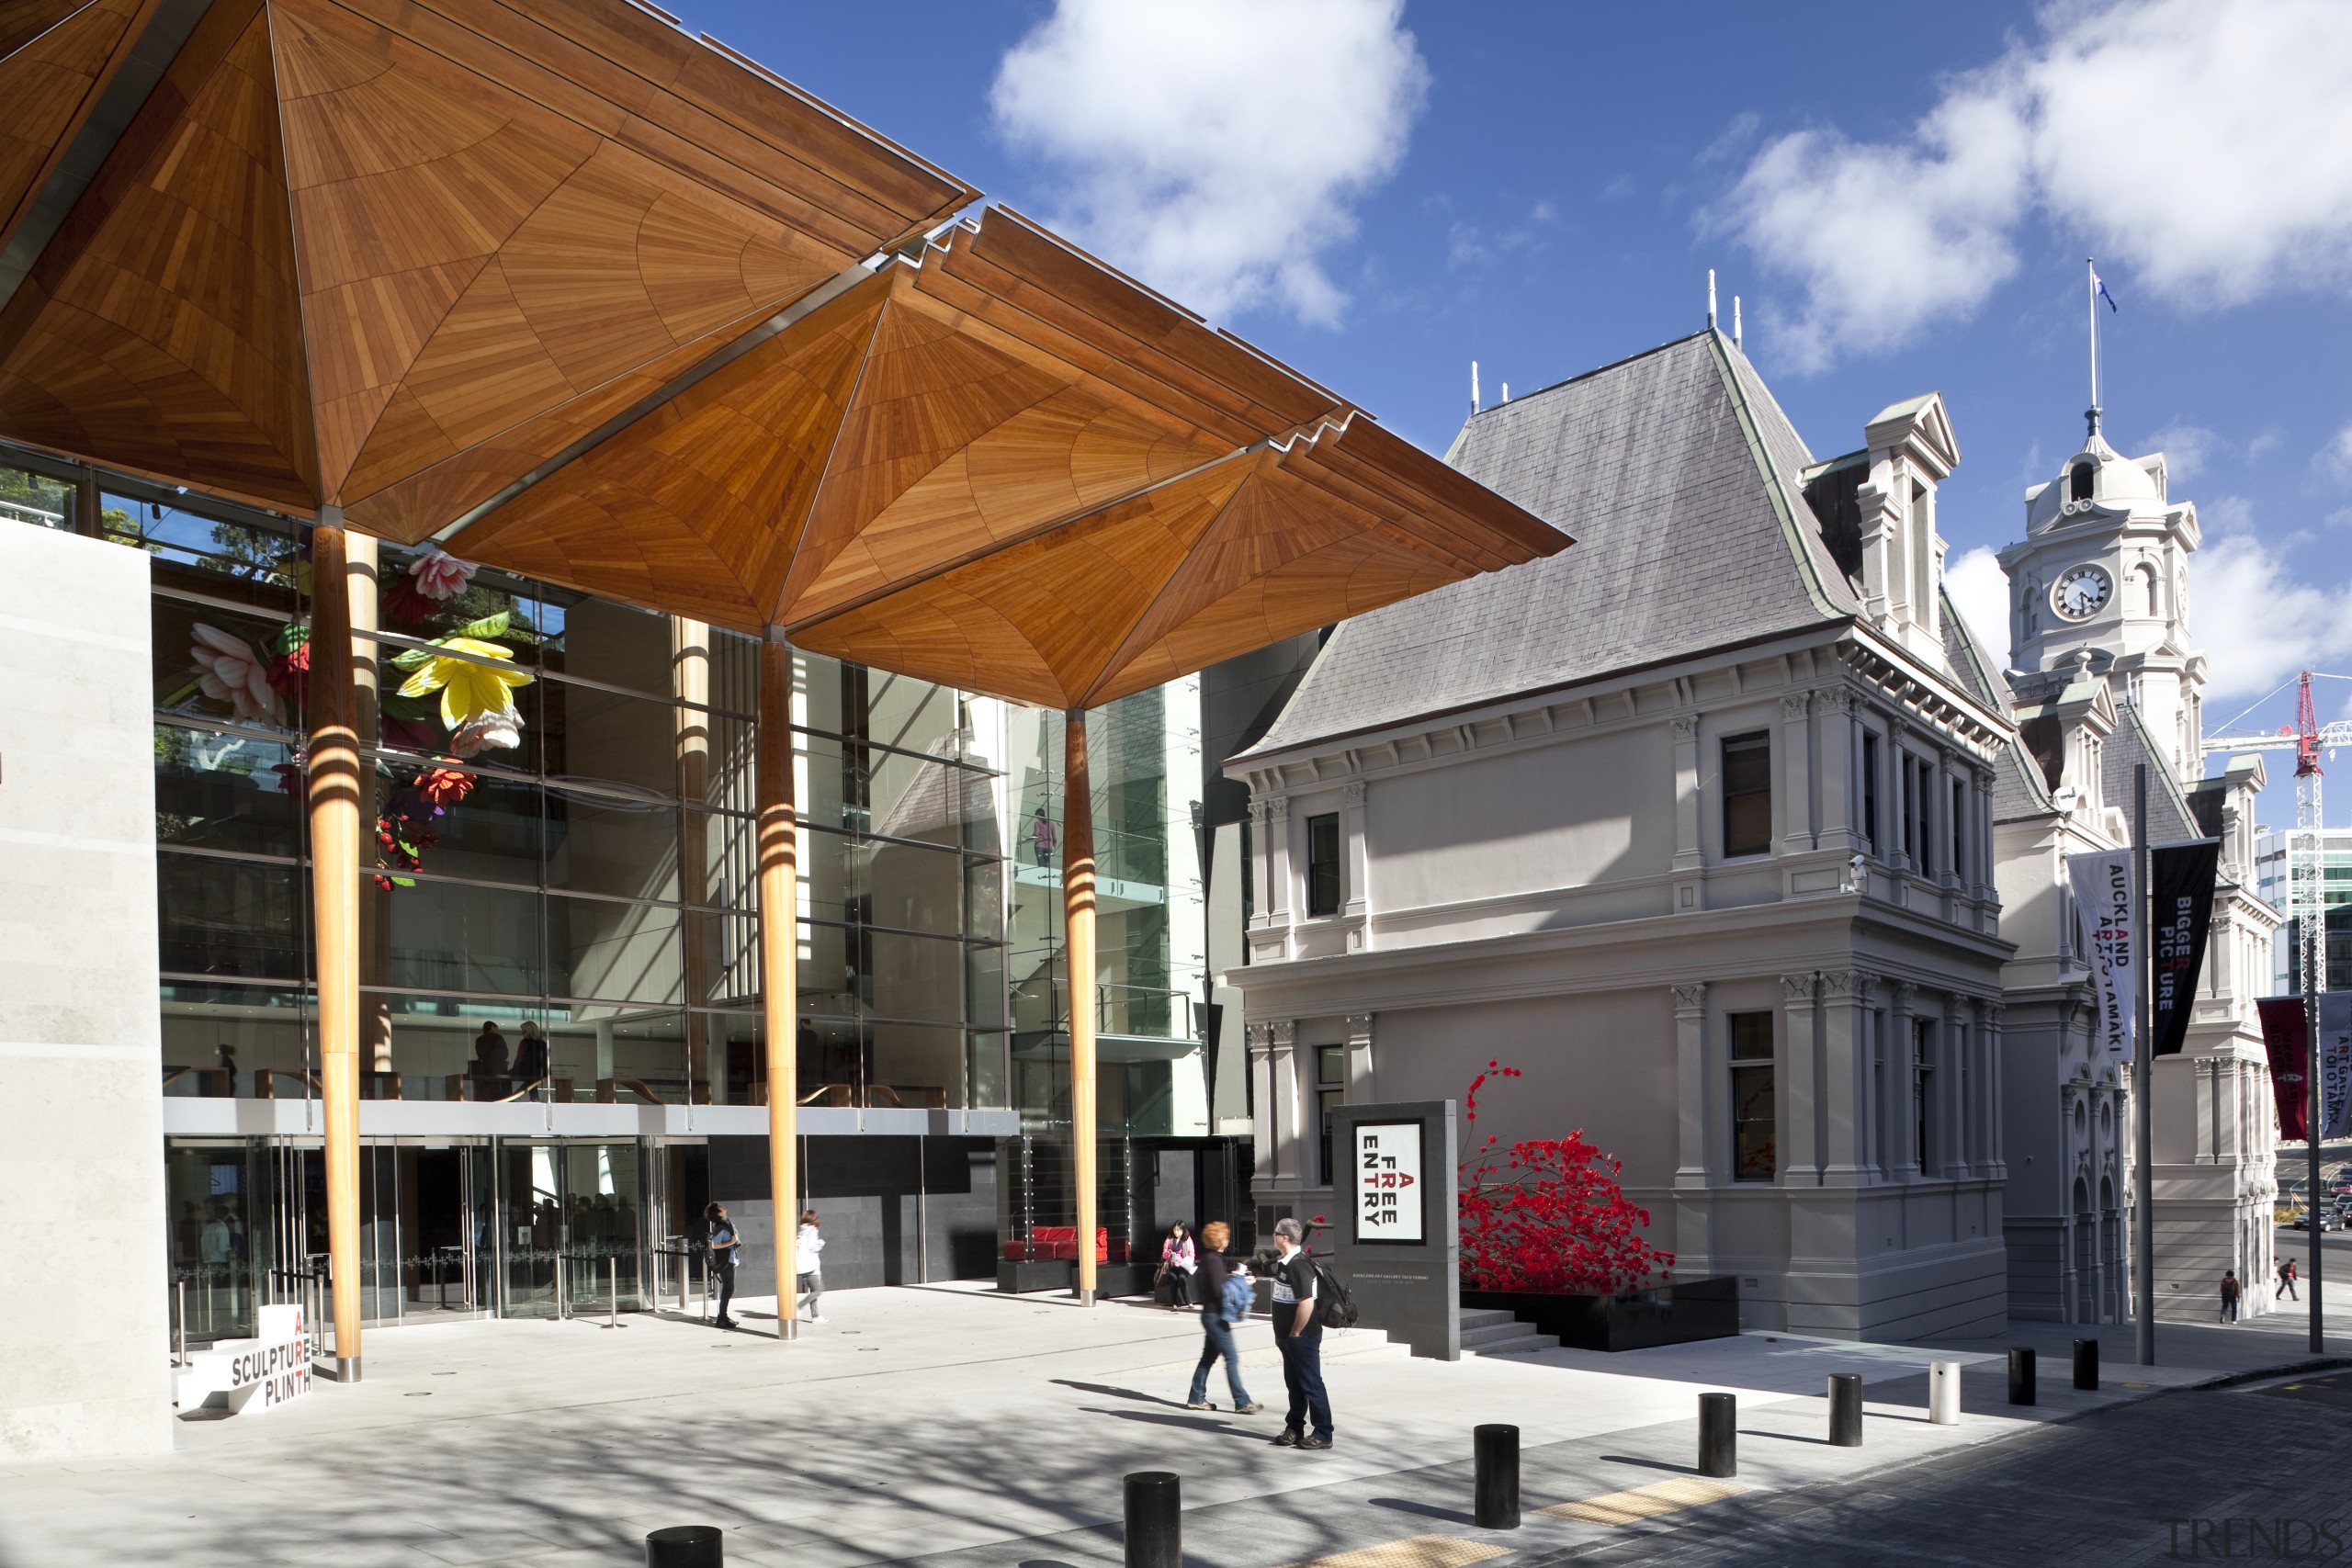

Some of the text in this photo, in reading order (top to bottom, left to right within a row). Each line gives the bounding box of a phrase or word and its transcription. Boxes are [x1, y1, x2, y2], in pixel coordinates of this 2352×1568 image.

[2109, 864, 2130, 967] AUCKLAND
[2176, 897, 2191, 969] BIGGER
[2159, 926, 2175, 1010] PICTURE
[2279, 1030, 2301, 1115] MEMORABL
[2326, 1046, 2337, 1069] TOI
[2339, 1036, 2349, 1063] ART
[1363, 1135, 1380, 1227] ENTRY
[1381, 1156, 1397, 1224] FREE
[1399, 1172, 1414, 1189] A
[232, 1337, 311, 1386] SCULPTURE
[266, 1367, 311, 1407] PLINTH
